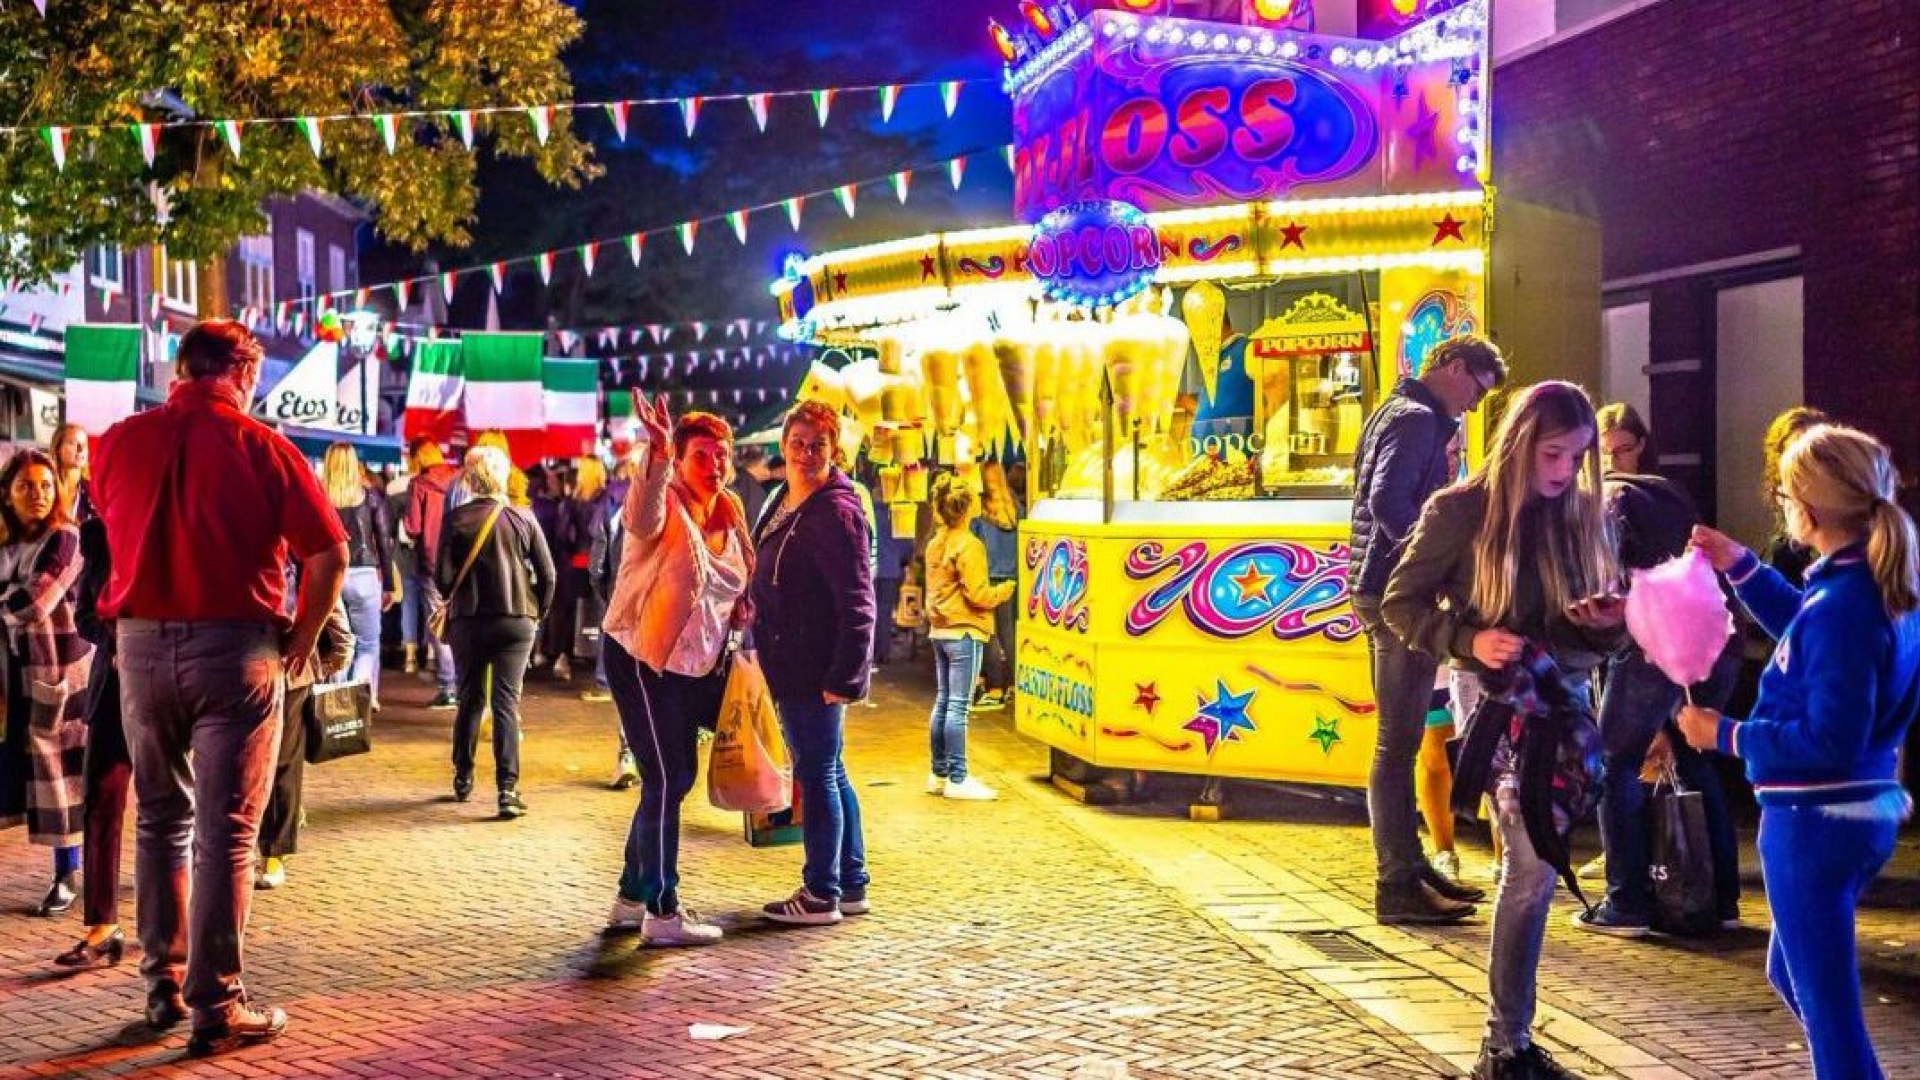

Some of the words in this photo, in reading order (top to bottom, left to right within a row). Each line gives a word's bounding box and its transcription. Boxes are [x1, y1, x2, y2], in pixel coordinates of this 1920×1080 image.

[1014, 222, 1181, 277] POPCORN
[1261, 334, 1362, 352] POPCORN
[277, 390, 327, 423] Etos
